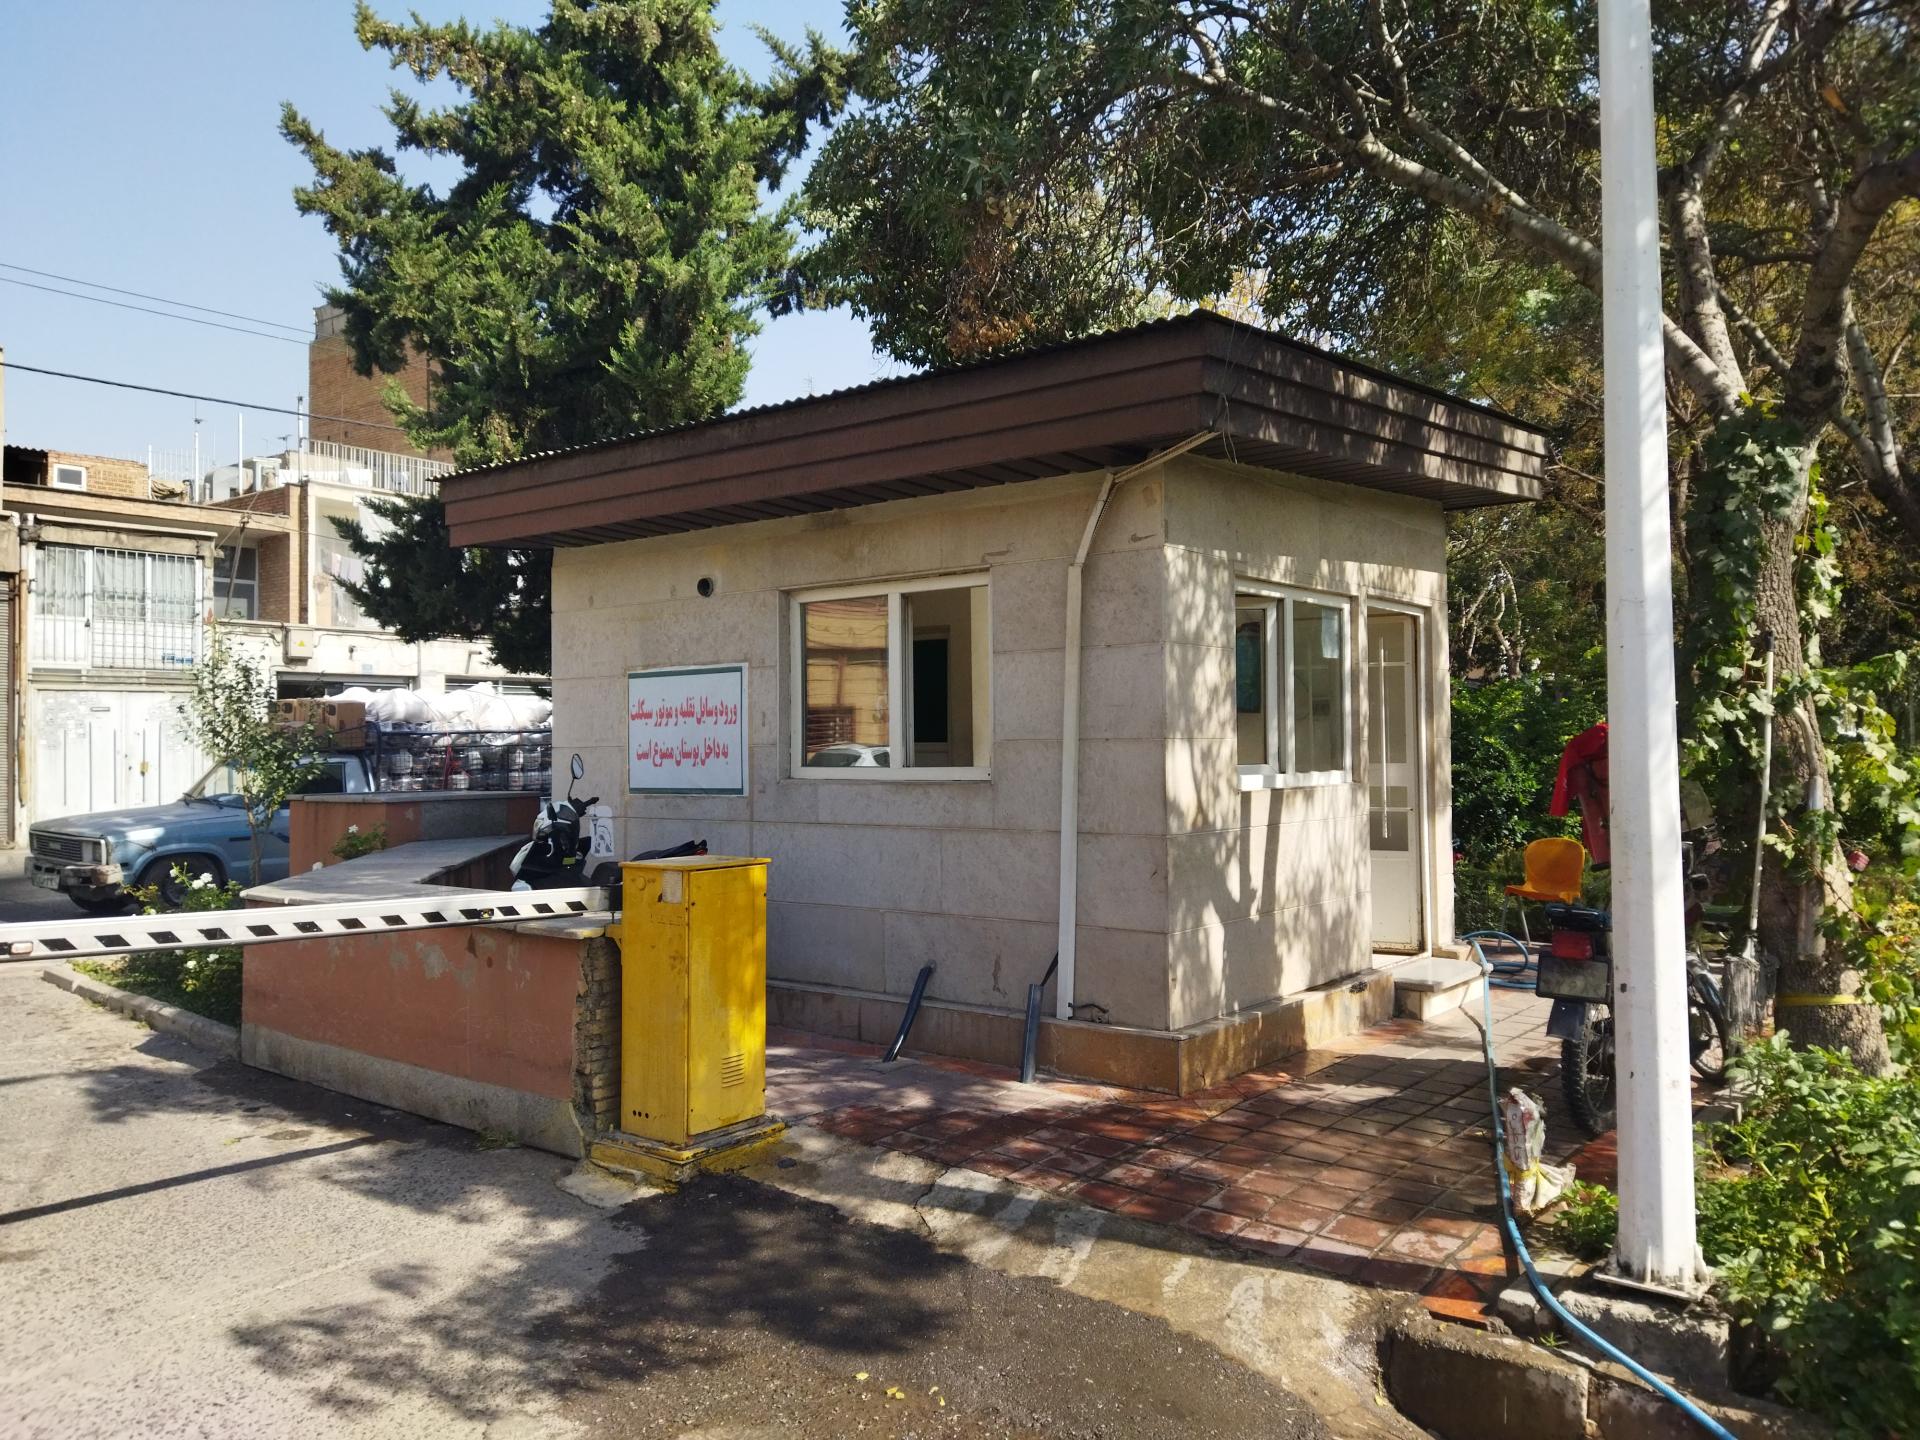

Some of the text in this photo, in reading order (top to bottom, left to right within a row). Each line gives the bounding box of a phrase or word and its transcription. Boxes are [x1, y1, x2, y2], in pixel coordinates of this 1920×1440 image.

[630, 698, 653, 726] سیکلت
[654, 698, 672, 727] موتور
[674, 705, 679, 726] و
[719, 699, 737, 724] ورود
[636, 736, 728, 767] به داخل بوستان ممنوع است
